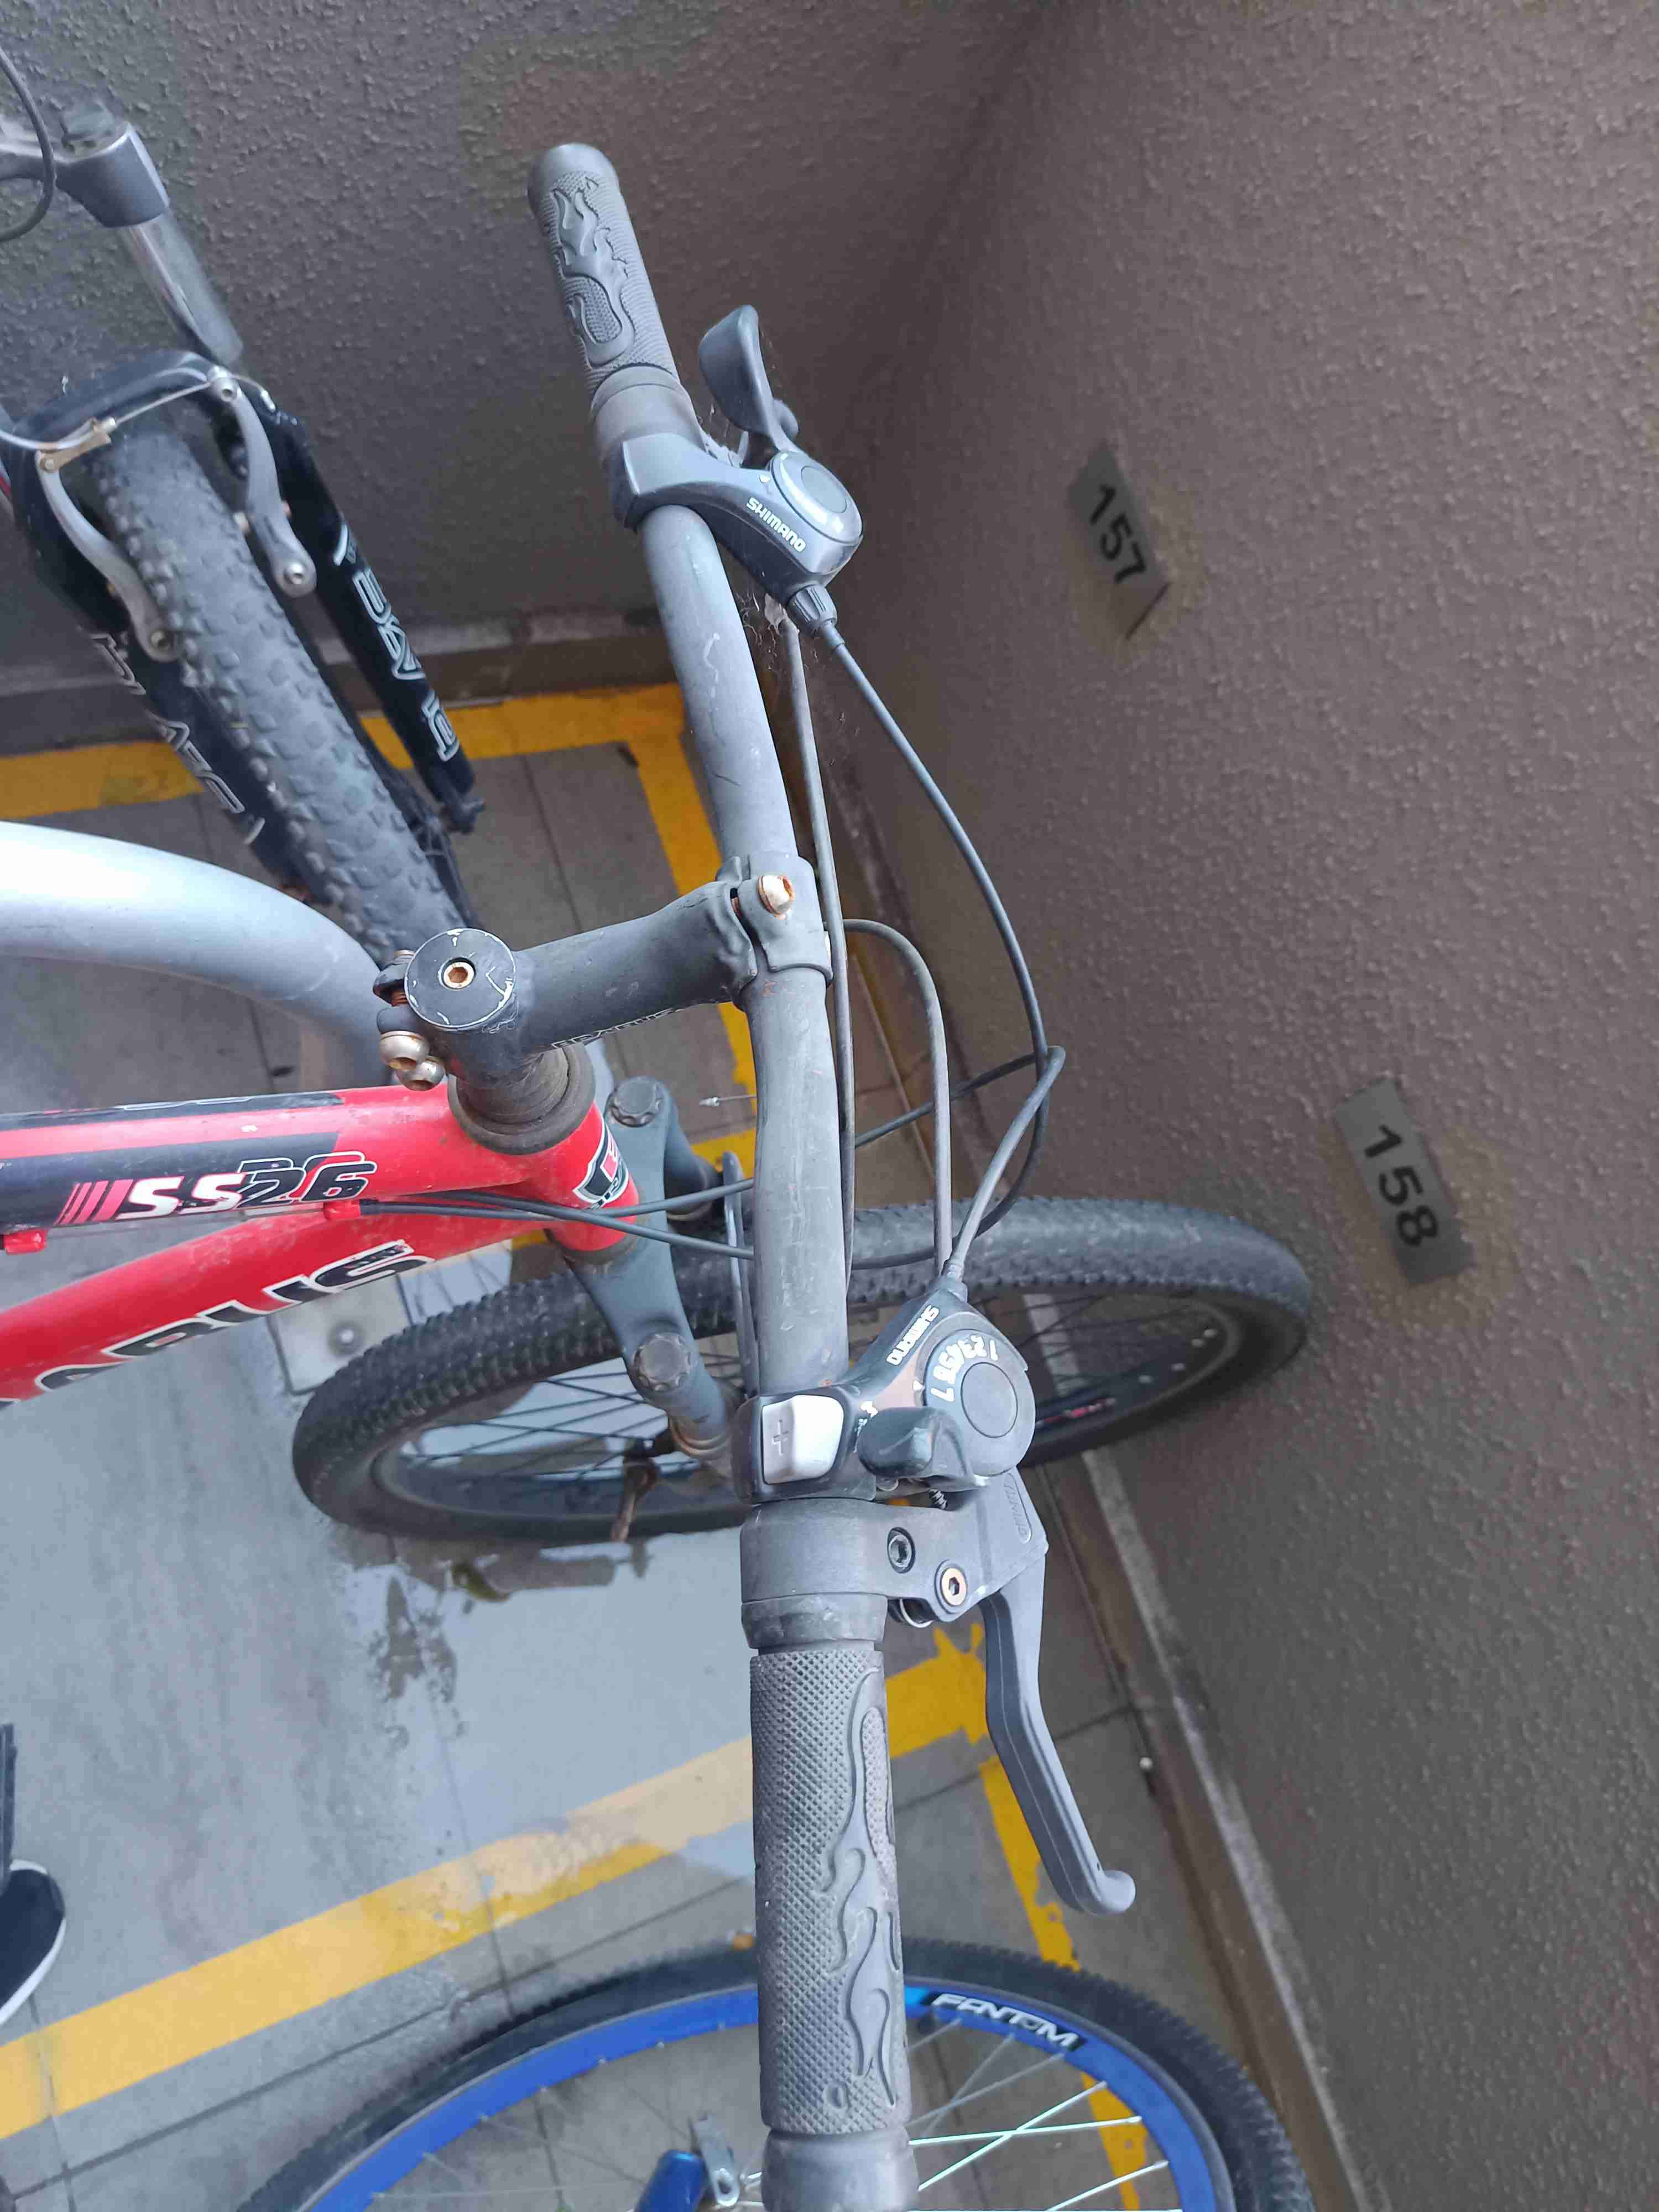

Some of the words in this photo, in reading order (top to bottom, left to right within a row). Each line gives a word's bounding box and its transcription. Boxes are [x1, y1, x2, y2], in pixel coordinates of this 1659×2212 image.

[746, 497, 806, 553] SHIMANO
[1090, 483, 1146, 584] 157
[1363, 1124, 1438, 1246] 158
[886, 1304, 939, 1367] SHIMANO
[931, 1992, 1080, 2049] FANTOM
